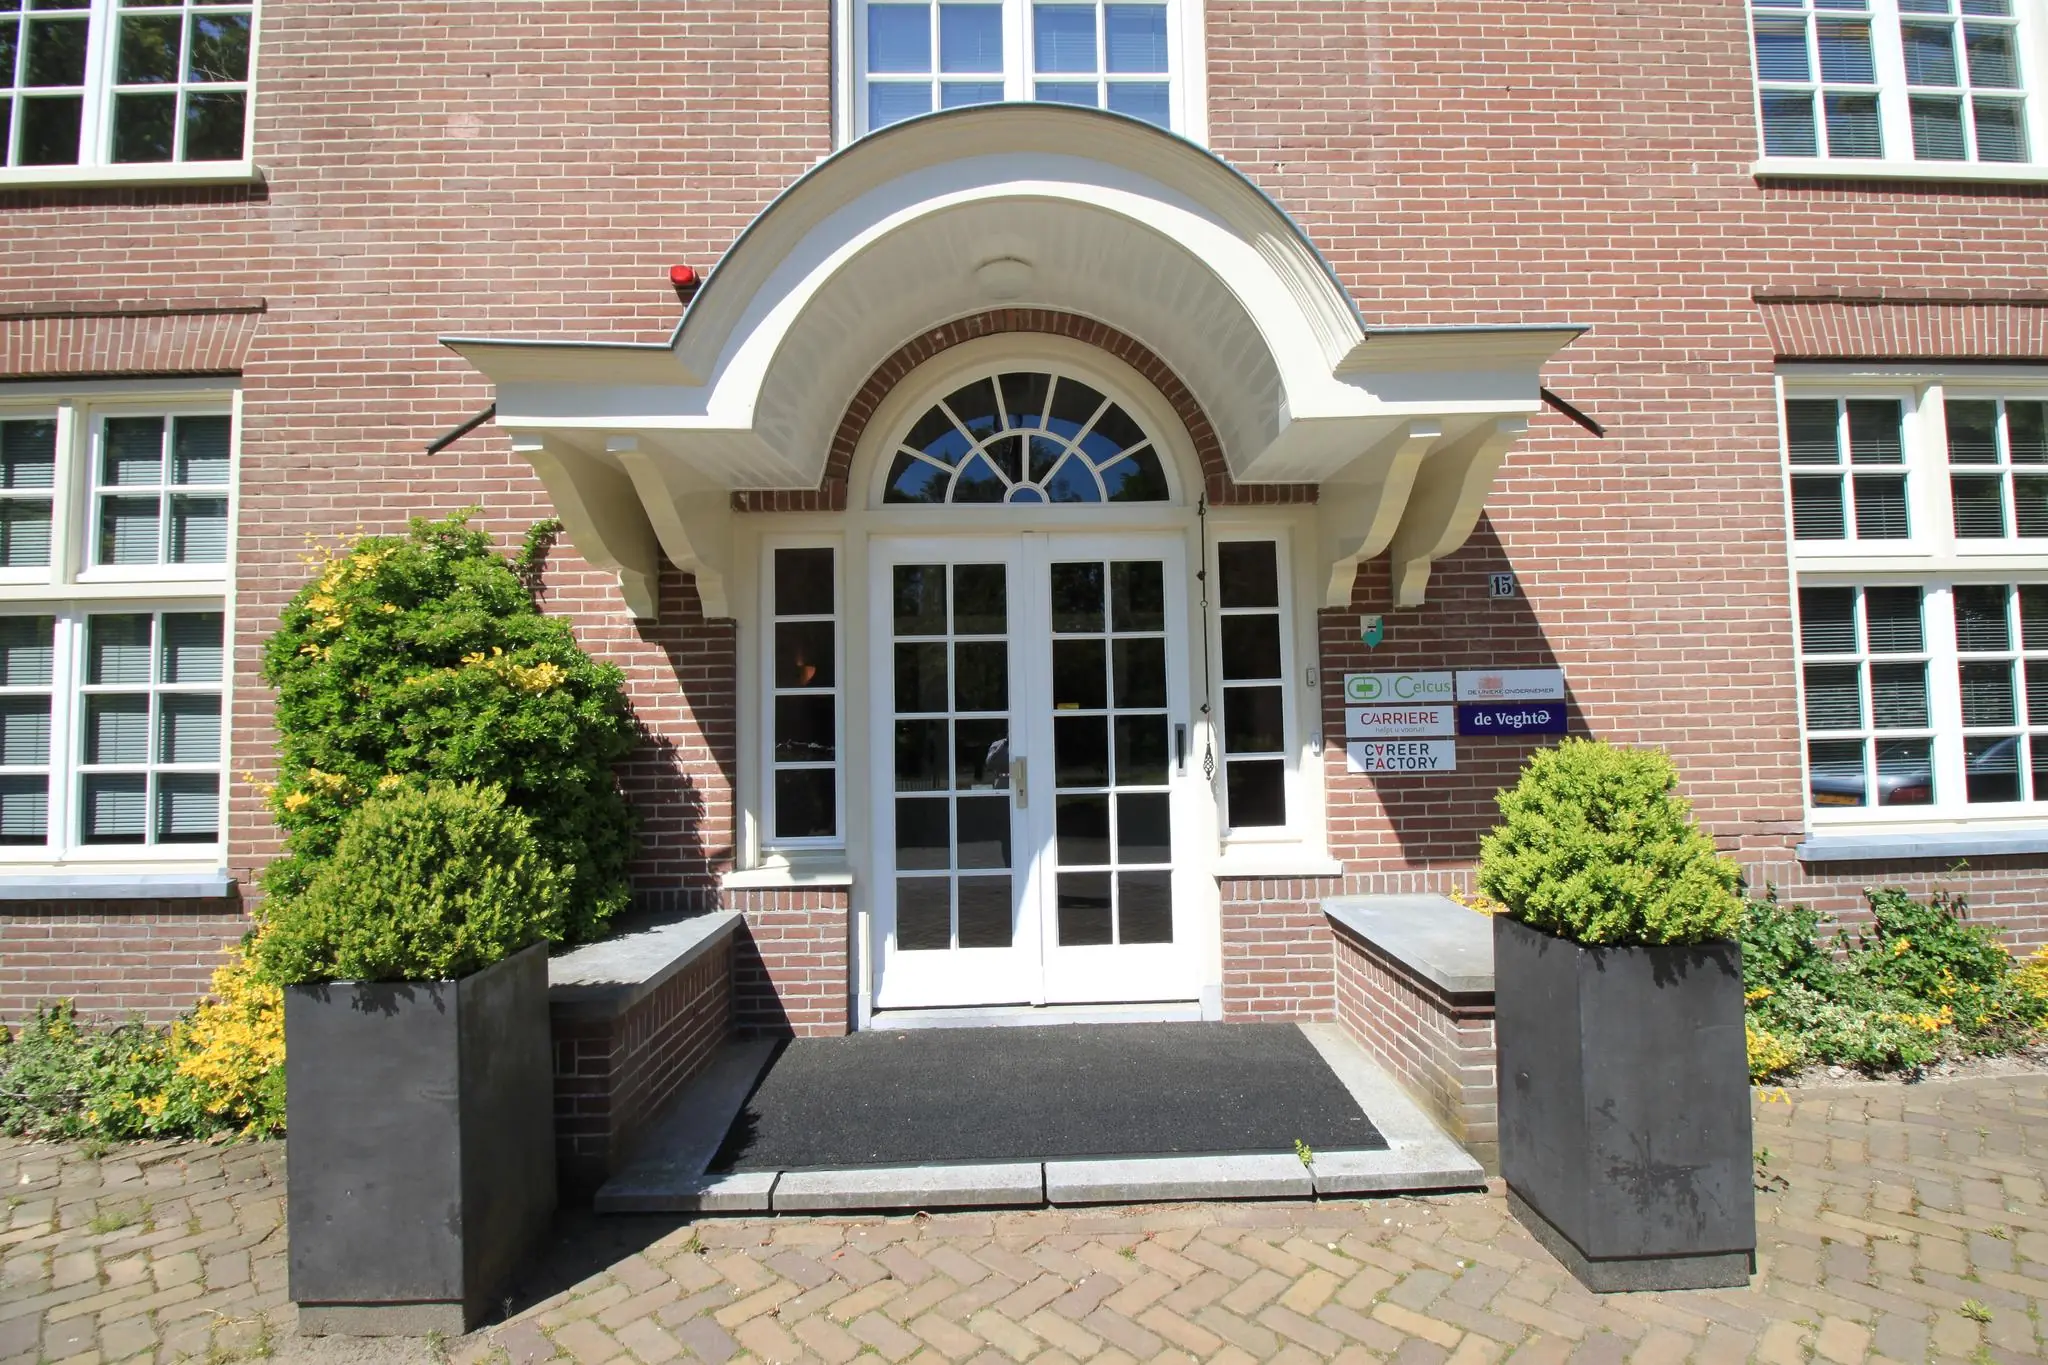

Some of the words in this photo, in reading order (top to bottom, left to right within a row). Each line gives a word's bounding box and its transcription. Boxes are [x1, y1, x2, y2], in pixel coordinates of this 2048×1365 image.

[1493, 576, 1512, 595] 15
[1394, 676, 1451, 698] Celcus
[1505, 687, 1554, 695] ONDERNEMER
[1361, 711, 1439, 725] CARRIERE
[1474, 712, 1491, 725] de
[1495, 710, 1551, 728] Veghte
[1364, 743, 1429, 756] CAREER
[1365, 757, 1438, 769] FACTORY
